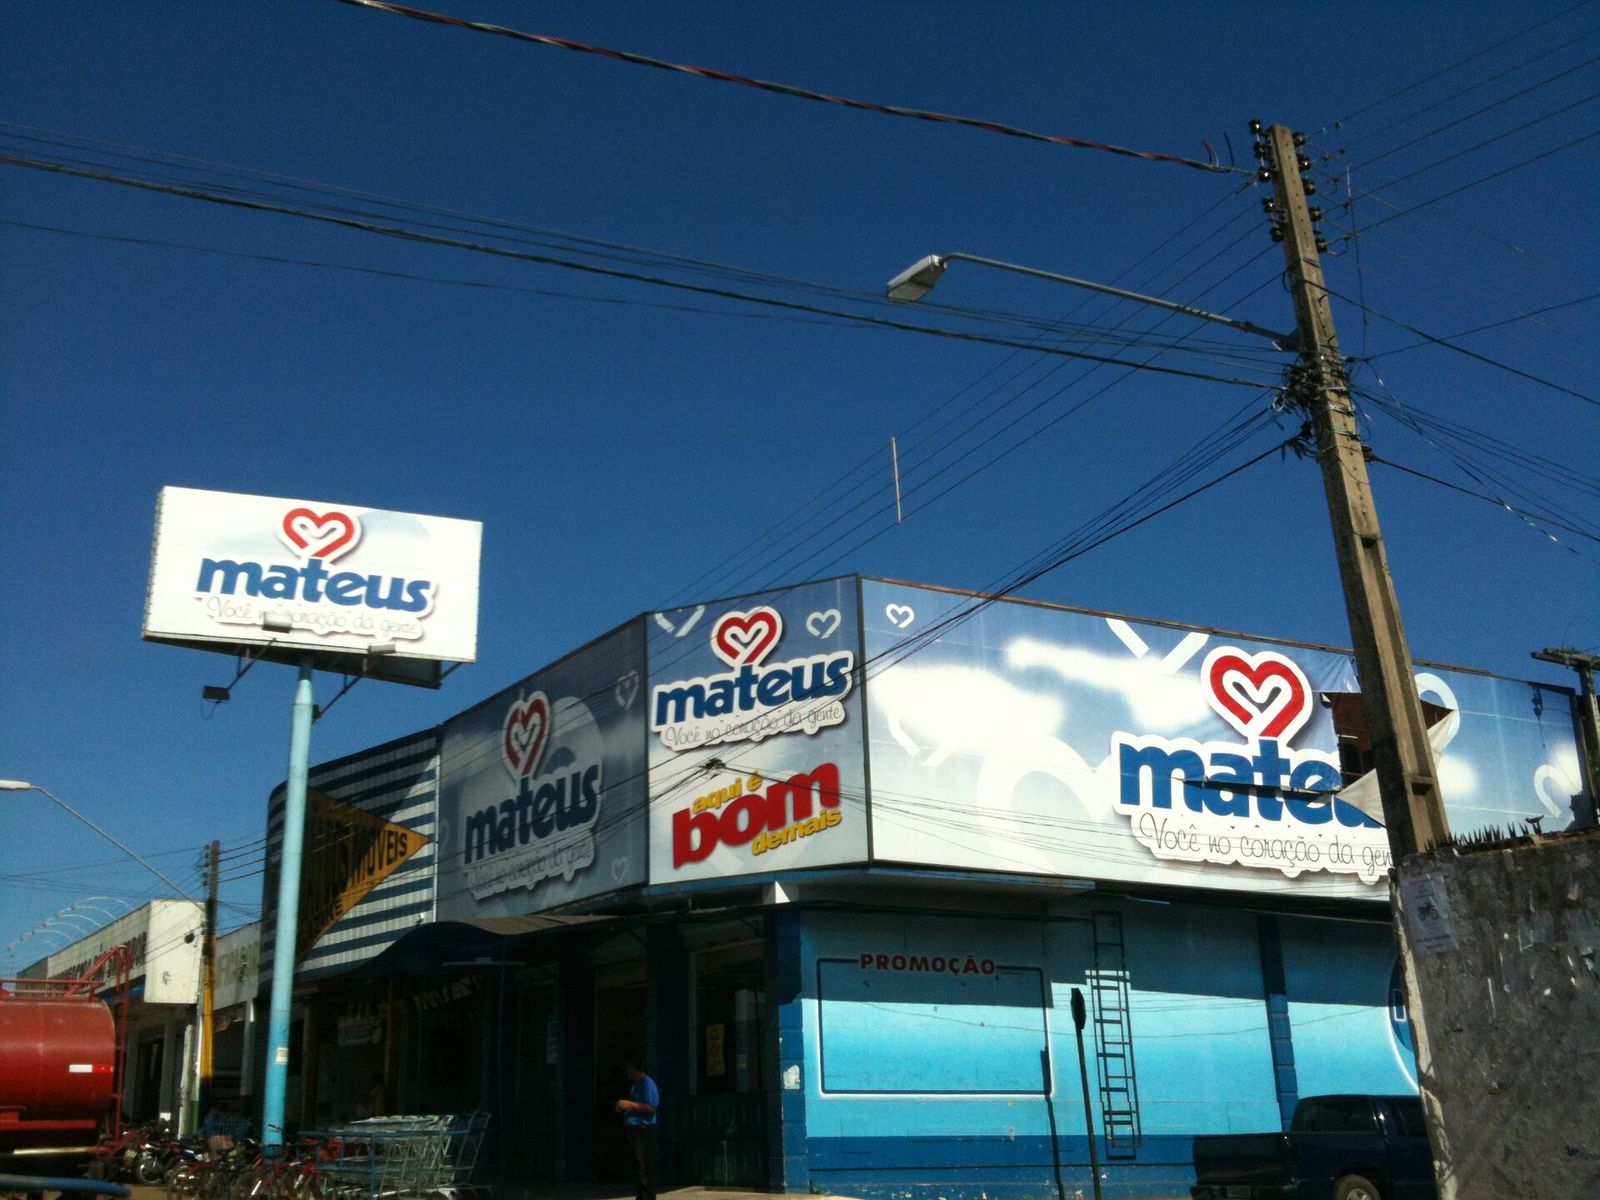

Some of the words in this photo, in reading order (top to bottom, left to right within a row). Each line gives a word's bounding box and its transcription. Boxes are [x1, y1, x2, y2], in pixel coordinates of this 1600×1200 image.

[196, 557, 431, 613] mateus
[207, 597, 250, 619] Você
[353, 611, 375, 630] da
[656, 656, 850, 727] mateus
[665, 726, 700, 746] Você
[705, 727, 720, 740] no
[808, 706, 842, 728] gente
[692, 776, 741, 815] aqui
[1119, 739, 1382, 829] mate
[464, 764, 599, 865] mateus
[673, 763, 840, 869] bom
[752, 808, 842, 856] demais
[1139, 812, 1201, 852] Você
[1208, 834, 1231, 855] no
[1240, 835, 1321, 868] coração
[1328, 835, 1355, 865] da
[1362, 846, 1392, 876] gen
[860, 953, 995, 976] PROMOÇÃO
